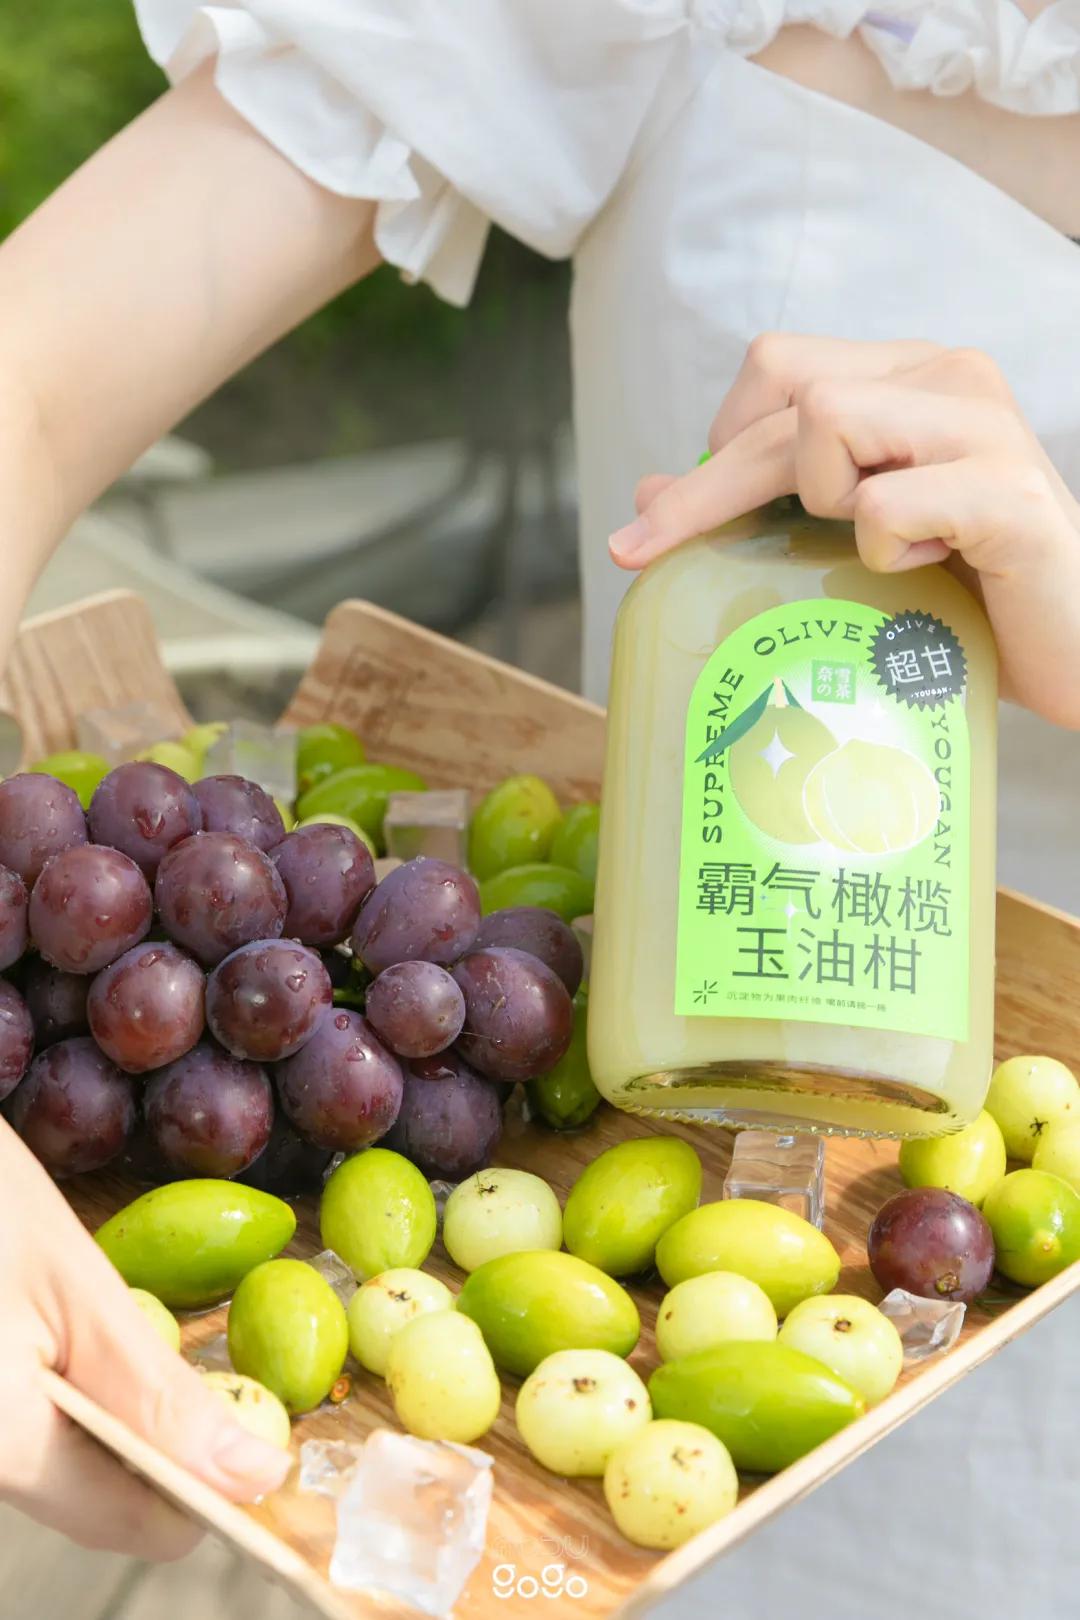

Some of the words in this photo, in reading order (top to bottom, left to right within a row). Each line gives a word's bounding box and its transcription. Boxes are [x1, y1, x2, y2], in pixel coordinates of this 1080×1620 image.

[753, 620, 863, 656] OLIVE
[886, 620, 936, 641] OLIVE
[885, 643, 952, 686] 超甘
[696, 861, 952, 937] 霸气橄榄
[732, 927, 922, 995] 玉油柑
